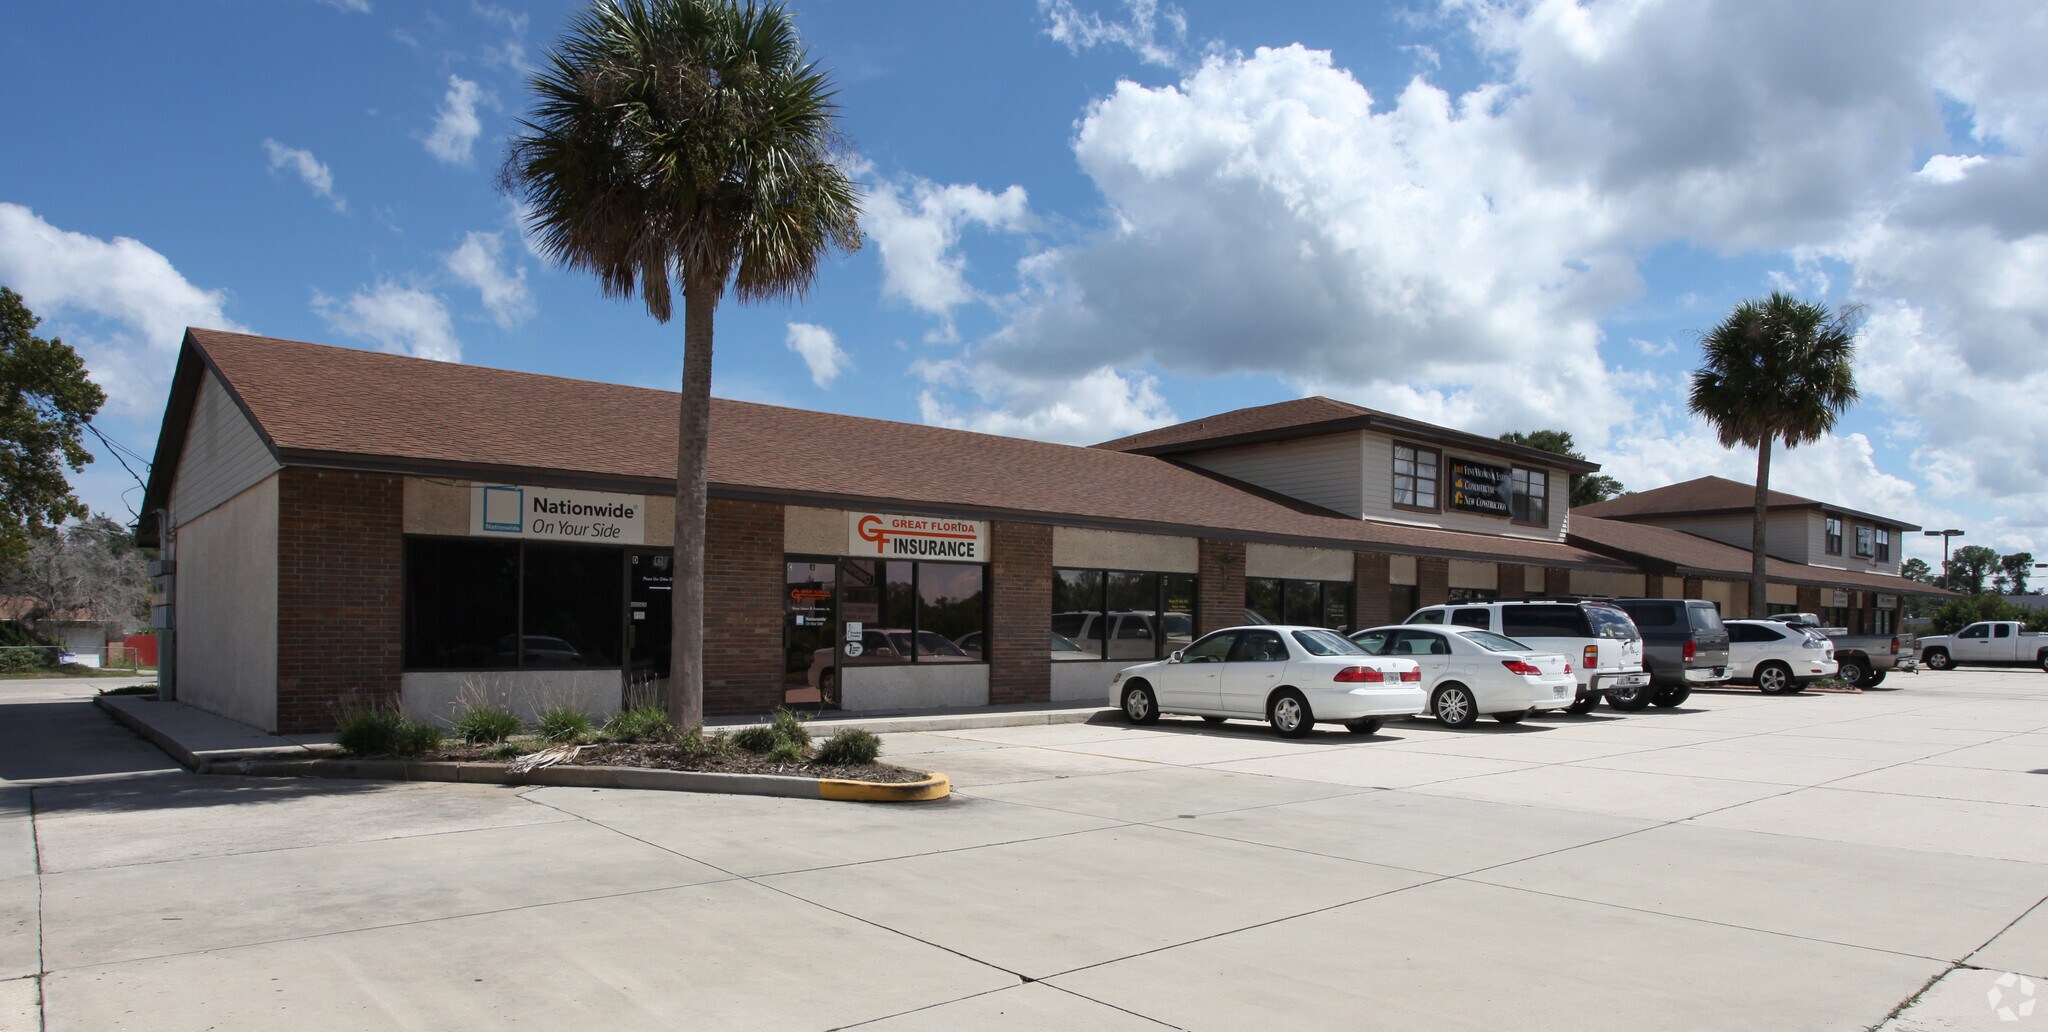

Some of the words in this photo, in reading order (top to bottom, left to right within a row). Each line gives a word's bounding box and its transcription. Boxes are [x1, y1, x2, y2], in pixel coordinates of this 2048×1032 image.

[533, 497, 634, 519] Nationwide
[1464, 495, 1475, 506] NEW
[1476, 497, 1506, 510] CONSTRUCTION
[485, 523, 521, 532] Nationwide
[532, 518, 554, 534] On
[558, 520, 589, 537] Your
[591, 522, 621, 538] Side
[892, 519, 928, 530] GREAT
[931, 521, 975, 533] FLORIDA
[893, 537, 975, 558] INSURANCE
